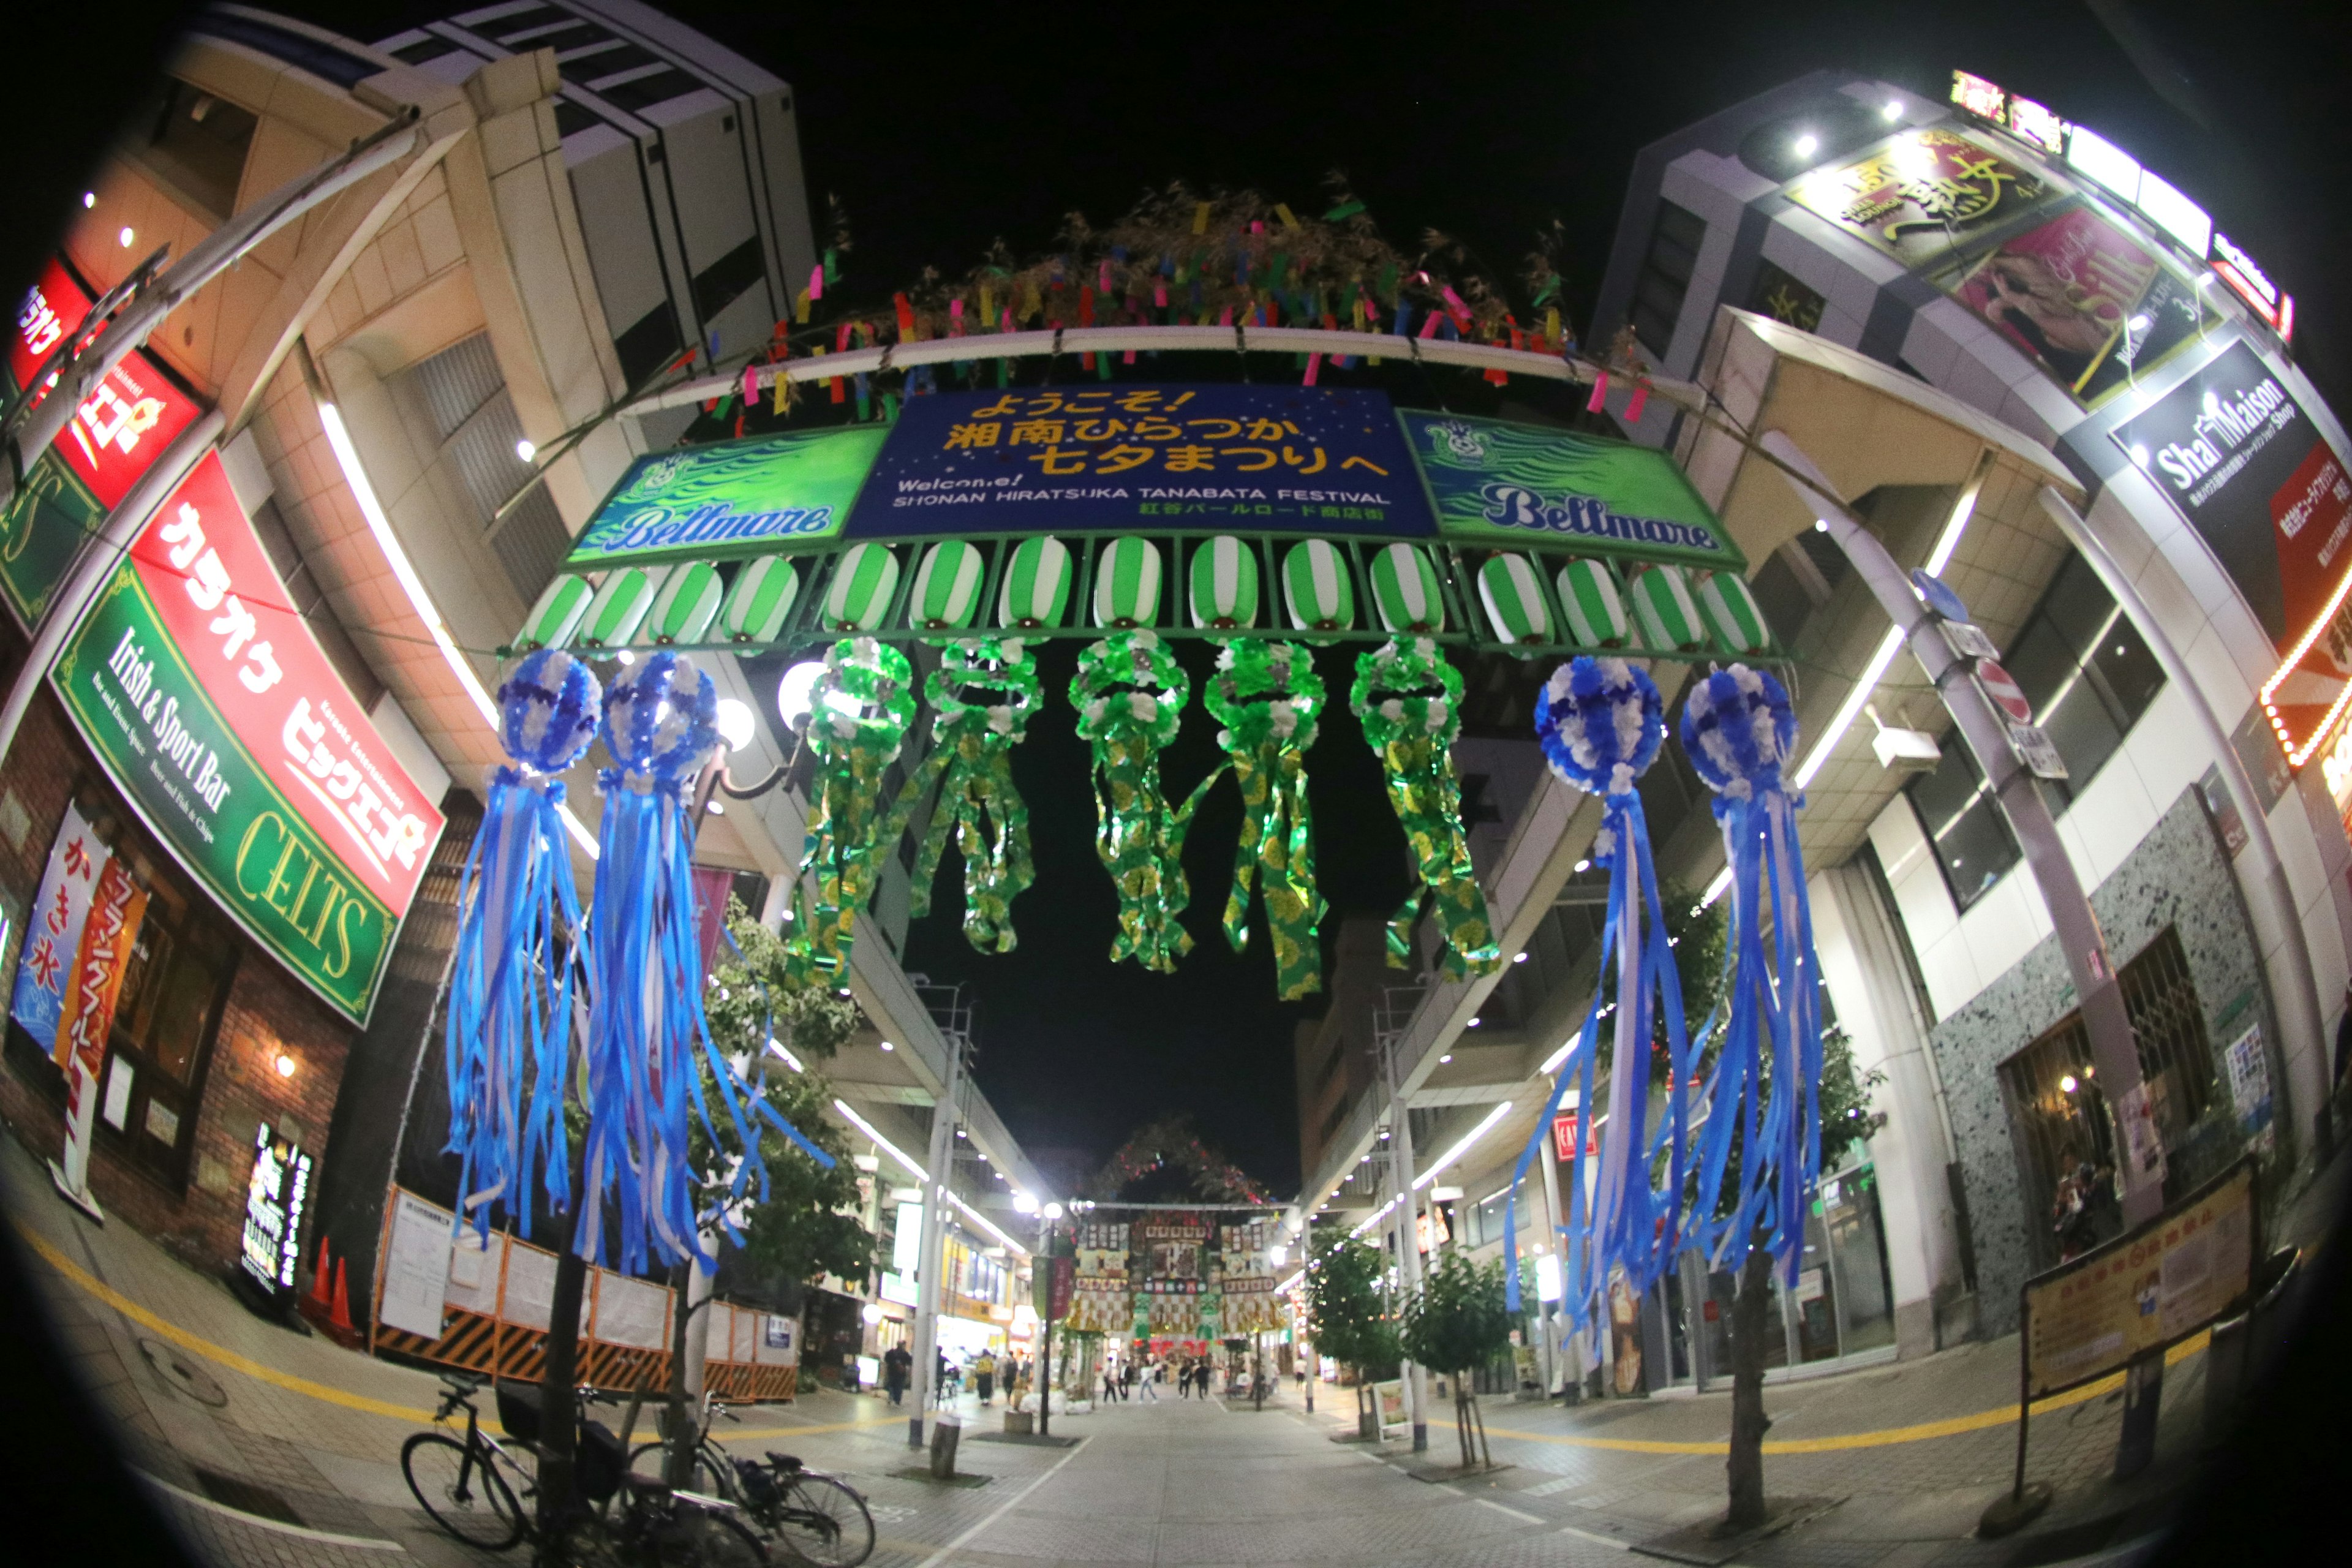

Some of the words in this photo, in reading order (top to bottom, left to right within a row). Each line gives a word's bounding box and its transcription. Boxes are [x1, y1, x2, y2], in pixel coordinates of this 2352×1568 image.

[971, 390, 1196, 419] ようこそ!
[2270, 402, 2297, 430] Shop
[943, 415, 1301, 450] 湘南ひらつか
[1029, 445, 1390, 476] 七夕まつりへ
[892, 492, 987, 508] SHONAN
[995, 489, 1129, 503] HIRATSUKA
[1138, 488, 1266, 500] TANABATA
[1277, 489, 1392, 505] FESTIVAL
[1138, 502, 1384, 521] 紅谷パールロード商店街
[1482, 482, 1720, 551] Bellmare
[603, 503, 831, 552] Bellmare
[160, 502, 284, 694] カラオケ
[108, 626, 154, 709] Irish
[141, 689, 162, 724] &
[154, 695, 204, 780] Sport
[191, 751, 232, 813] Bar
[318, 699, 354, 745] Karaoke
[349, 741, 405, 812] Entertainment
[28, 837, 91, 995] かき氷
[235, 810, 368, 979] CELTS
